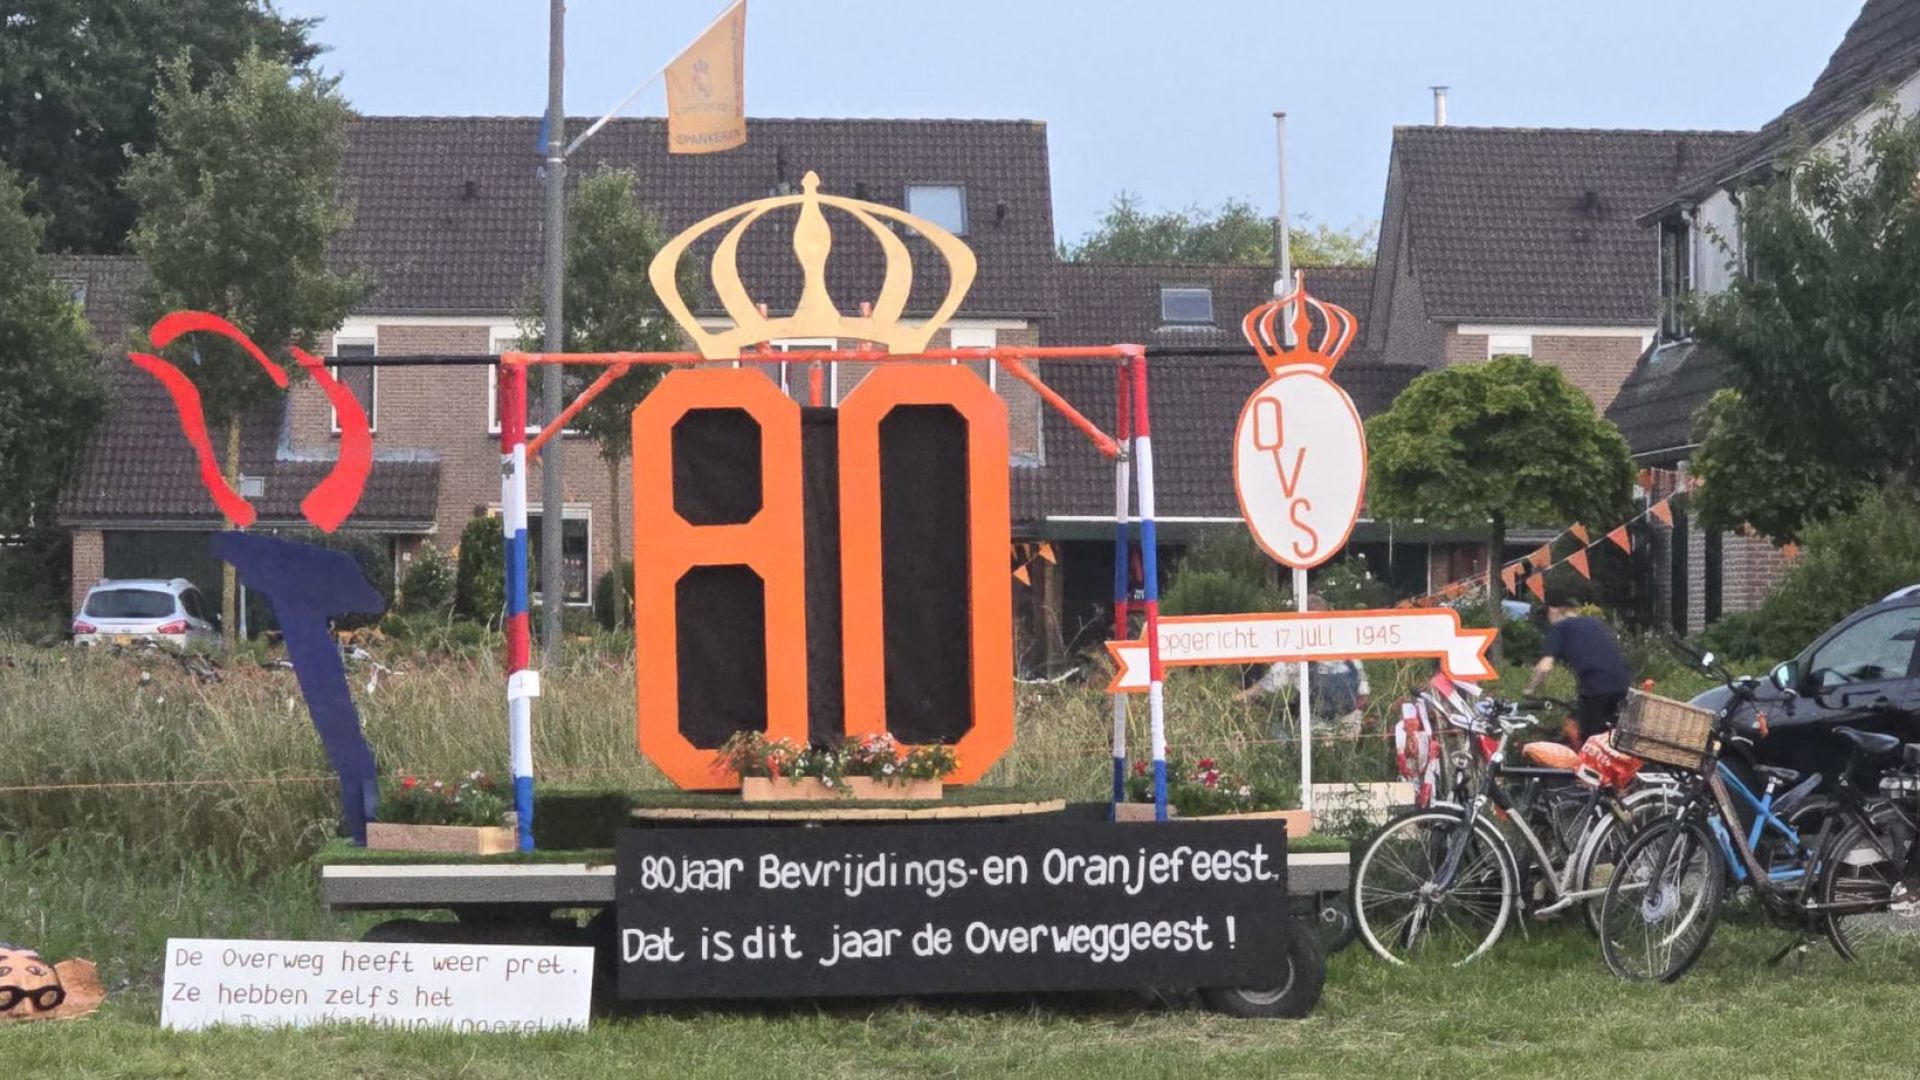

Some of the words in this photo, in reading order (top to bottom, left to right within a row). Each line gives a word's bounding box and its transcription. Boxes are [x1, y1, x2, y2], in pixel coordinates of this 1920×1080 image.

[631, 367, 1014, 789] 80
[1275, 628, 1291, 648] 17
[1356, 623, 1401, 645] 1945
[623, 926, 685, 963] Dat
[701, 927, 735, 962] is
[742, 924, 803, 960] dit
[818, 924, 903, 967] jaar
[911, 922, 953, 957] de
[175, 948, 203, 967] De
[222, 948, 324, 977] Overweg
[341, 949, 414, 973] heeft
[432, 953, 489, 972] weer
[172, 982, 201, 1002] Ze
[218, 982, 308, 1005] hebben
[325, 984, 399, 1009] zelfs
[415, 985, 452, 1007] het
